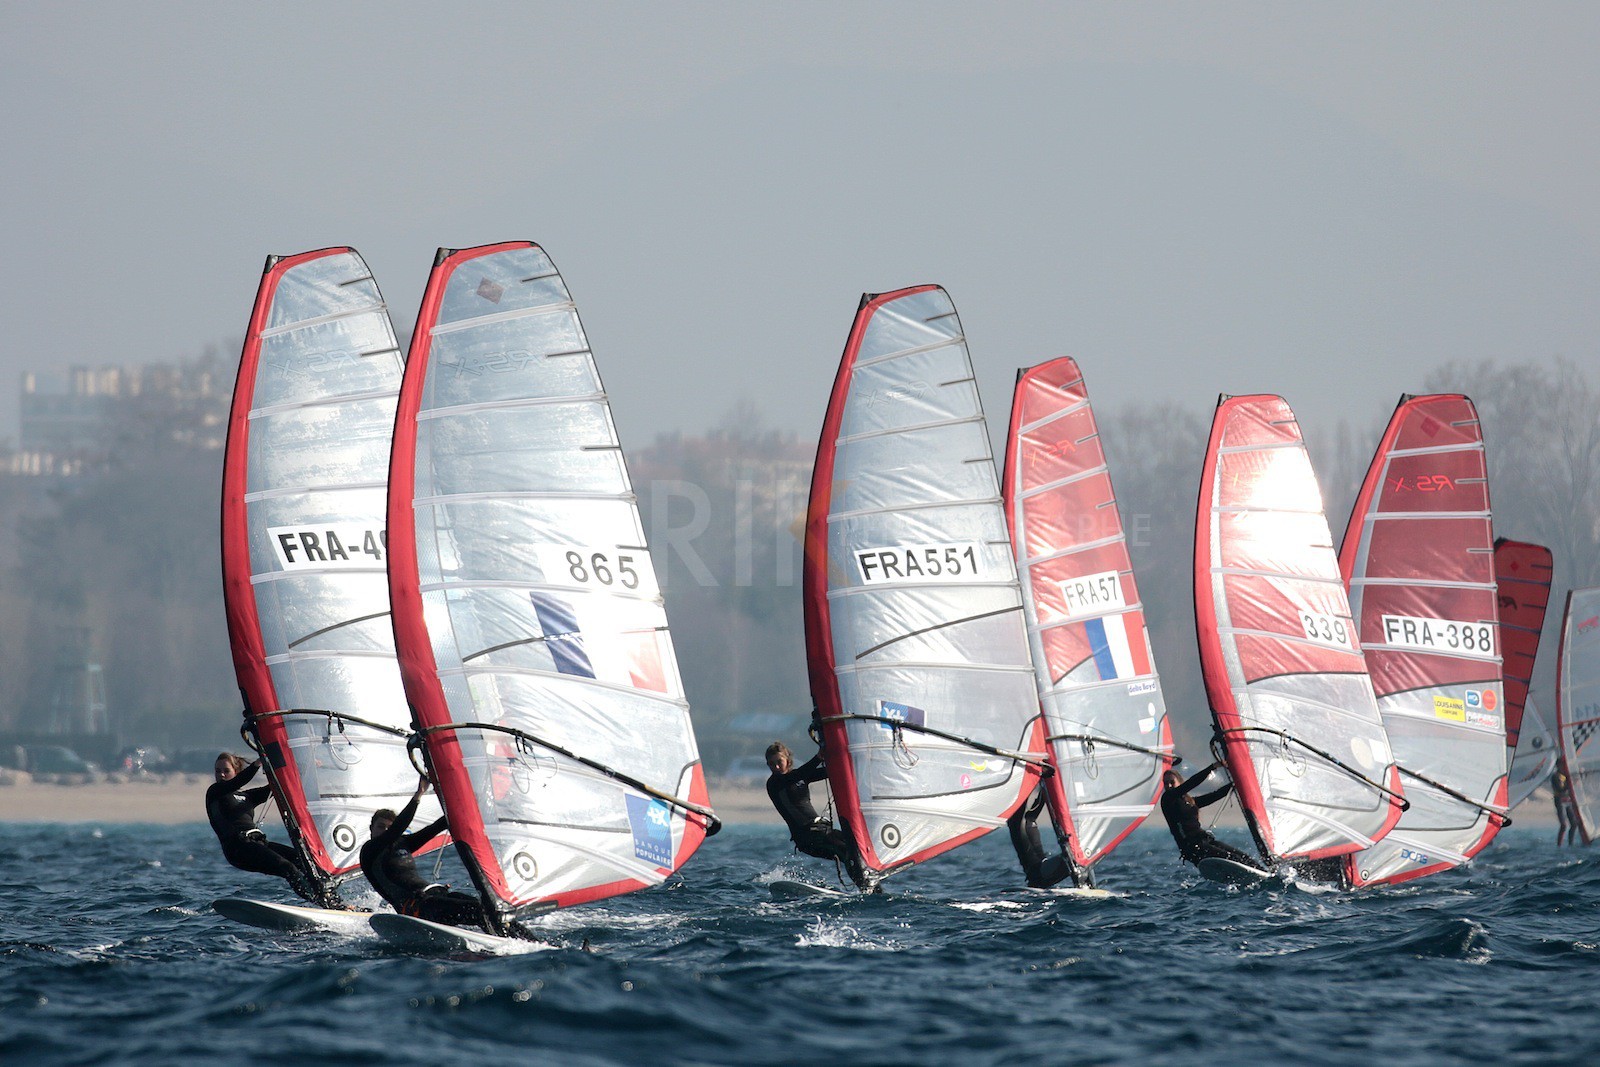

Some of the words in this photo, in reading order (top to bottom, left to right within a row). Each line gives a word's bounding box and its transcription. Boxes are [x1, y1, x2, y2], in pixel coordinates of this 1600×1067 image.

[565, 550, 638, 590] 865
[859, 545, 978, 581] FRA551
[1064, 576, 1118, 609] FRA57
[1304, 614, 1347, 645] 339
[1385, 618, 1492, 653] FRA-388
[635, 839, 671, 856] BANQUE
[636, 848, 672, 866] POPULAIRE
